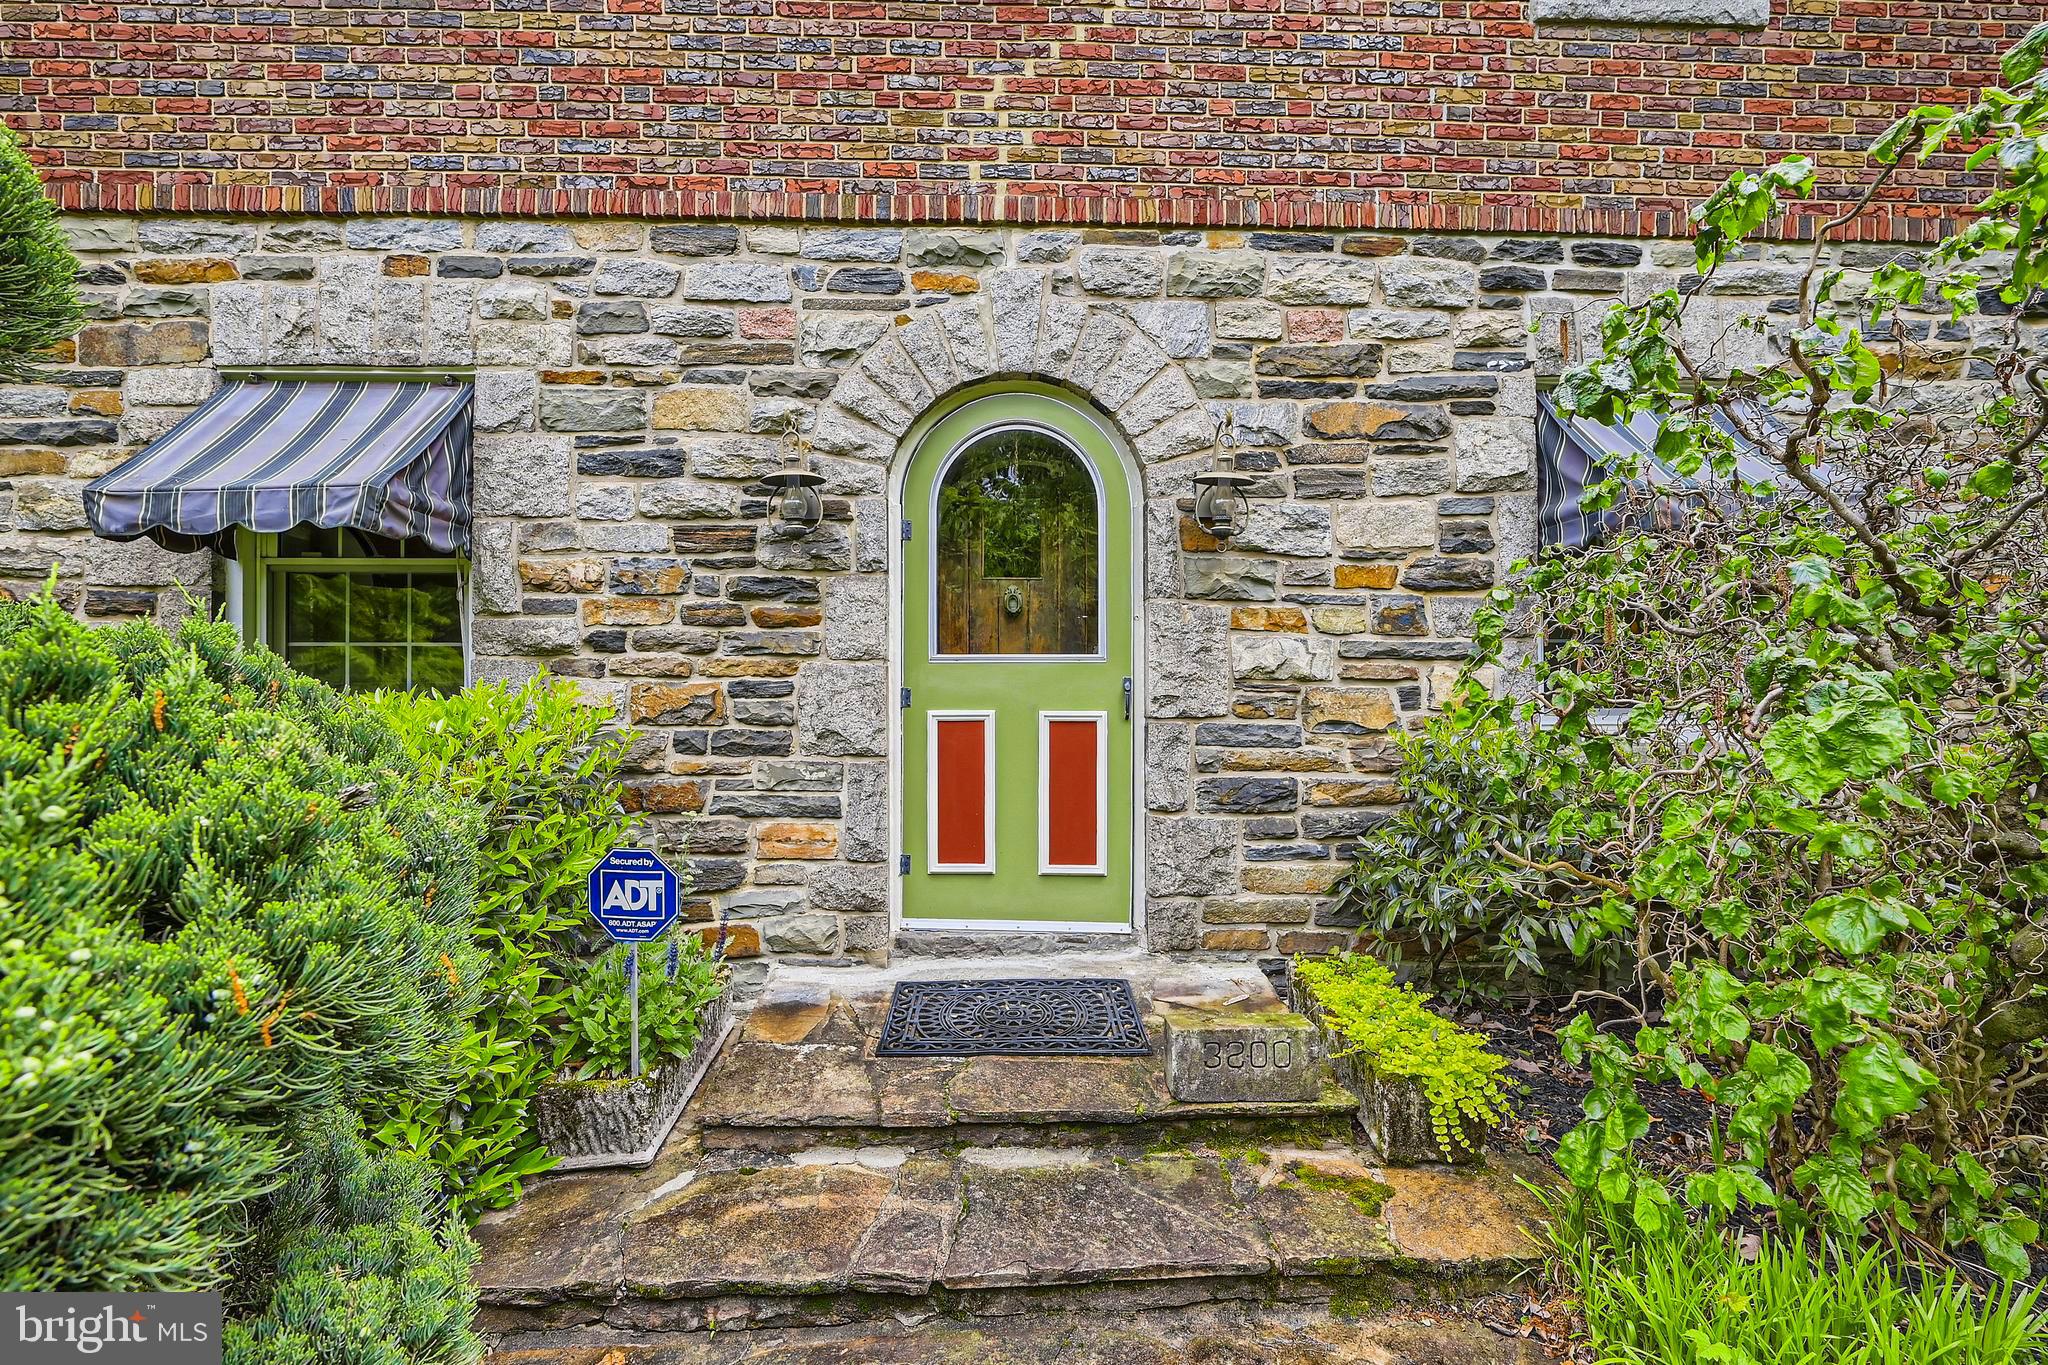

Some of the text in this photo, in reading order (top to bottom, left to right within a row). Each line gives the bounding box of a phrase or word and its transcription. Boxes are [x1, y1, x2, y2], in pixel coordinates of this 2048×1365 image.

[610, 857, 654, 867] Secured by
[603, 880, 664, 912] ADT
[1203, 1041, 1292, 1069] 3200
